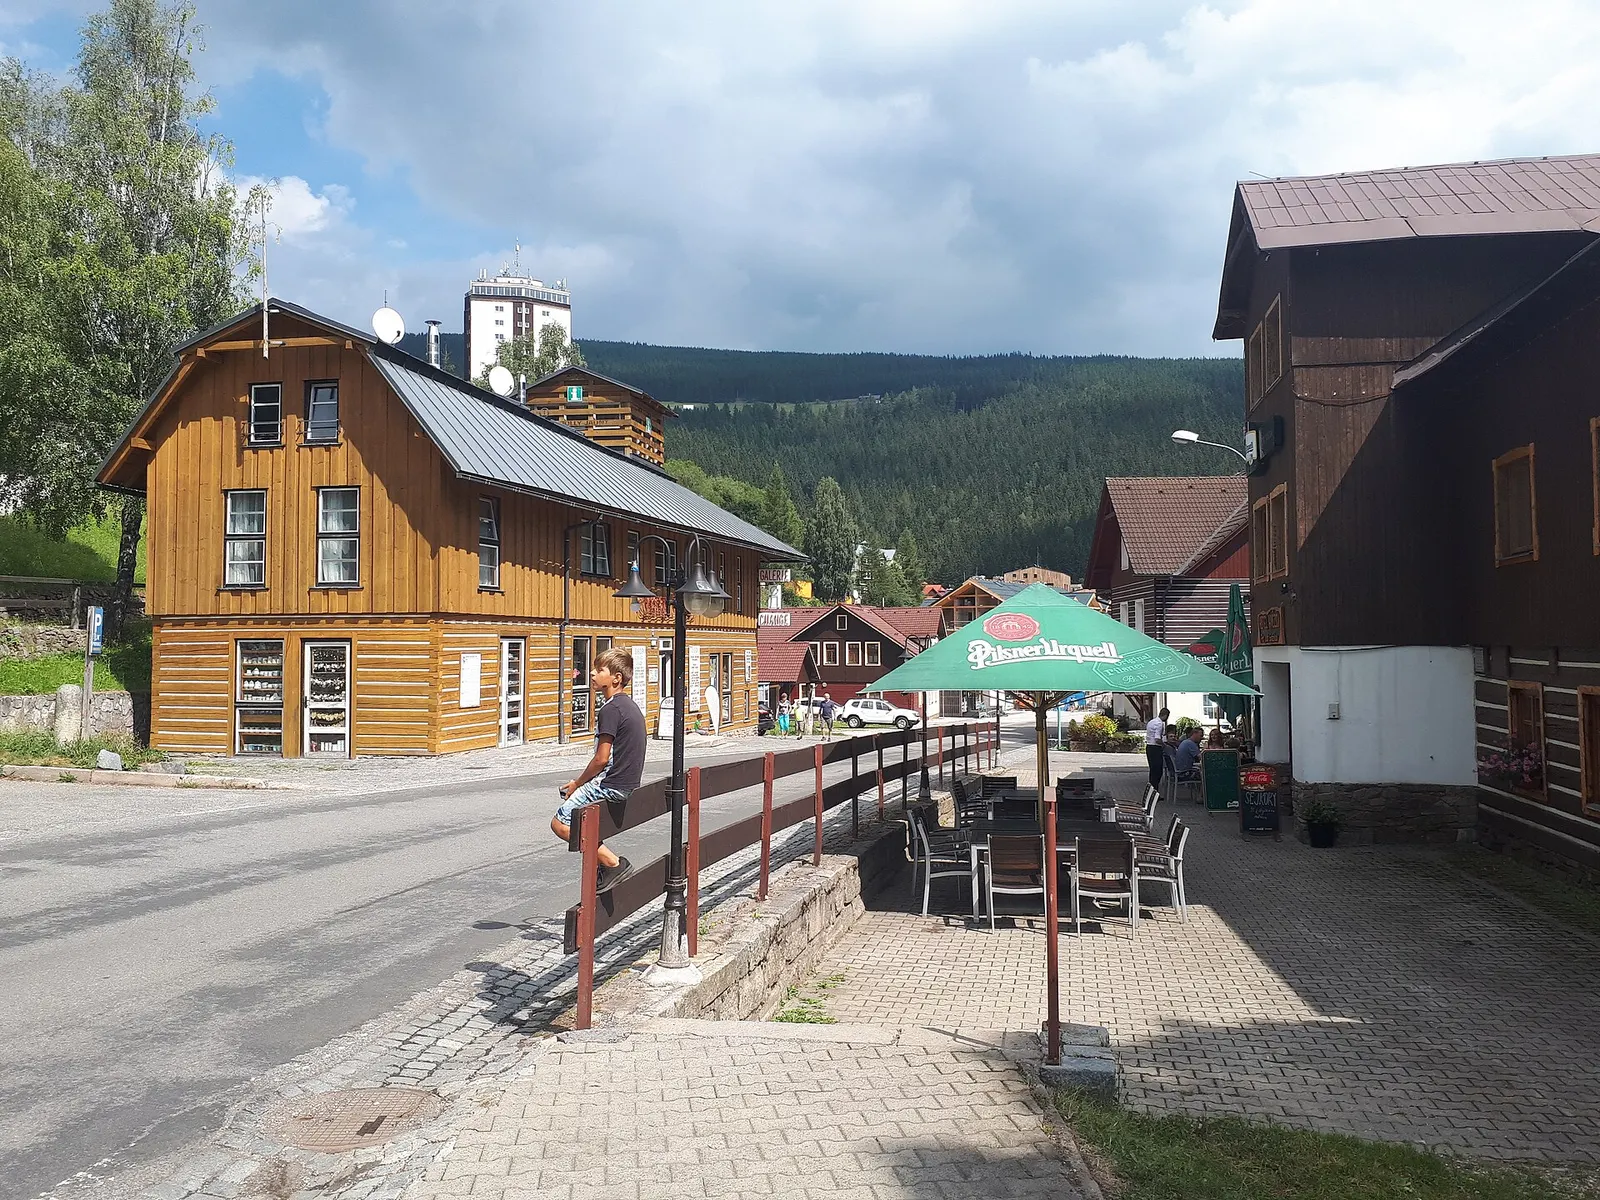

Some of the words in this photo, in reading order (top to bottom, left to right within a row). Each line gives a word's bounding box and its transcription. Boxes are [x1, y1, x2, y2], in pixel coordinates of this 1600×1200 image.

[760, 570, 788, 580] GALERIE
[95, 613, 102, 635] P
[760, 614, 788, 625] CHANGE
[967, 640, 1046, 670] Pilsner
[1038, 637, 1120, 663] Urquell
[1114, 653, 1152, 667] Original
[1103, 662, 1145, 677] Pilsner
[1146, 655, 1173, 666] Bier
